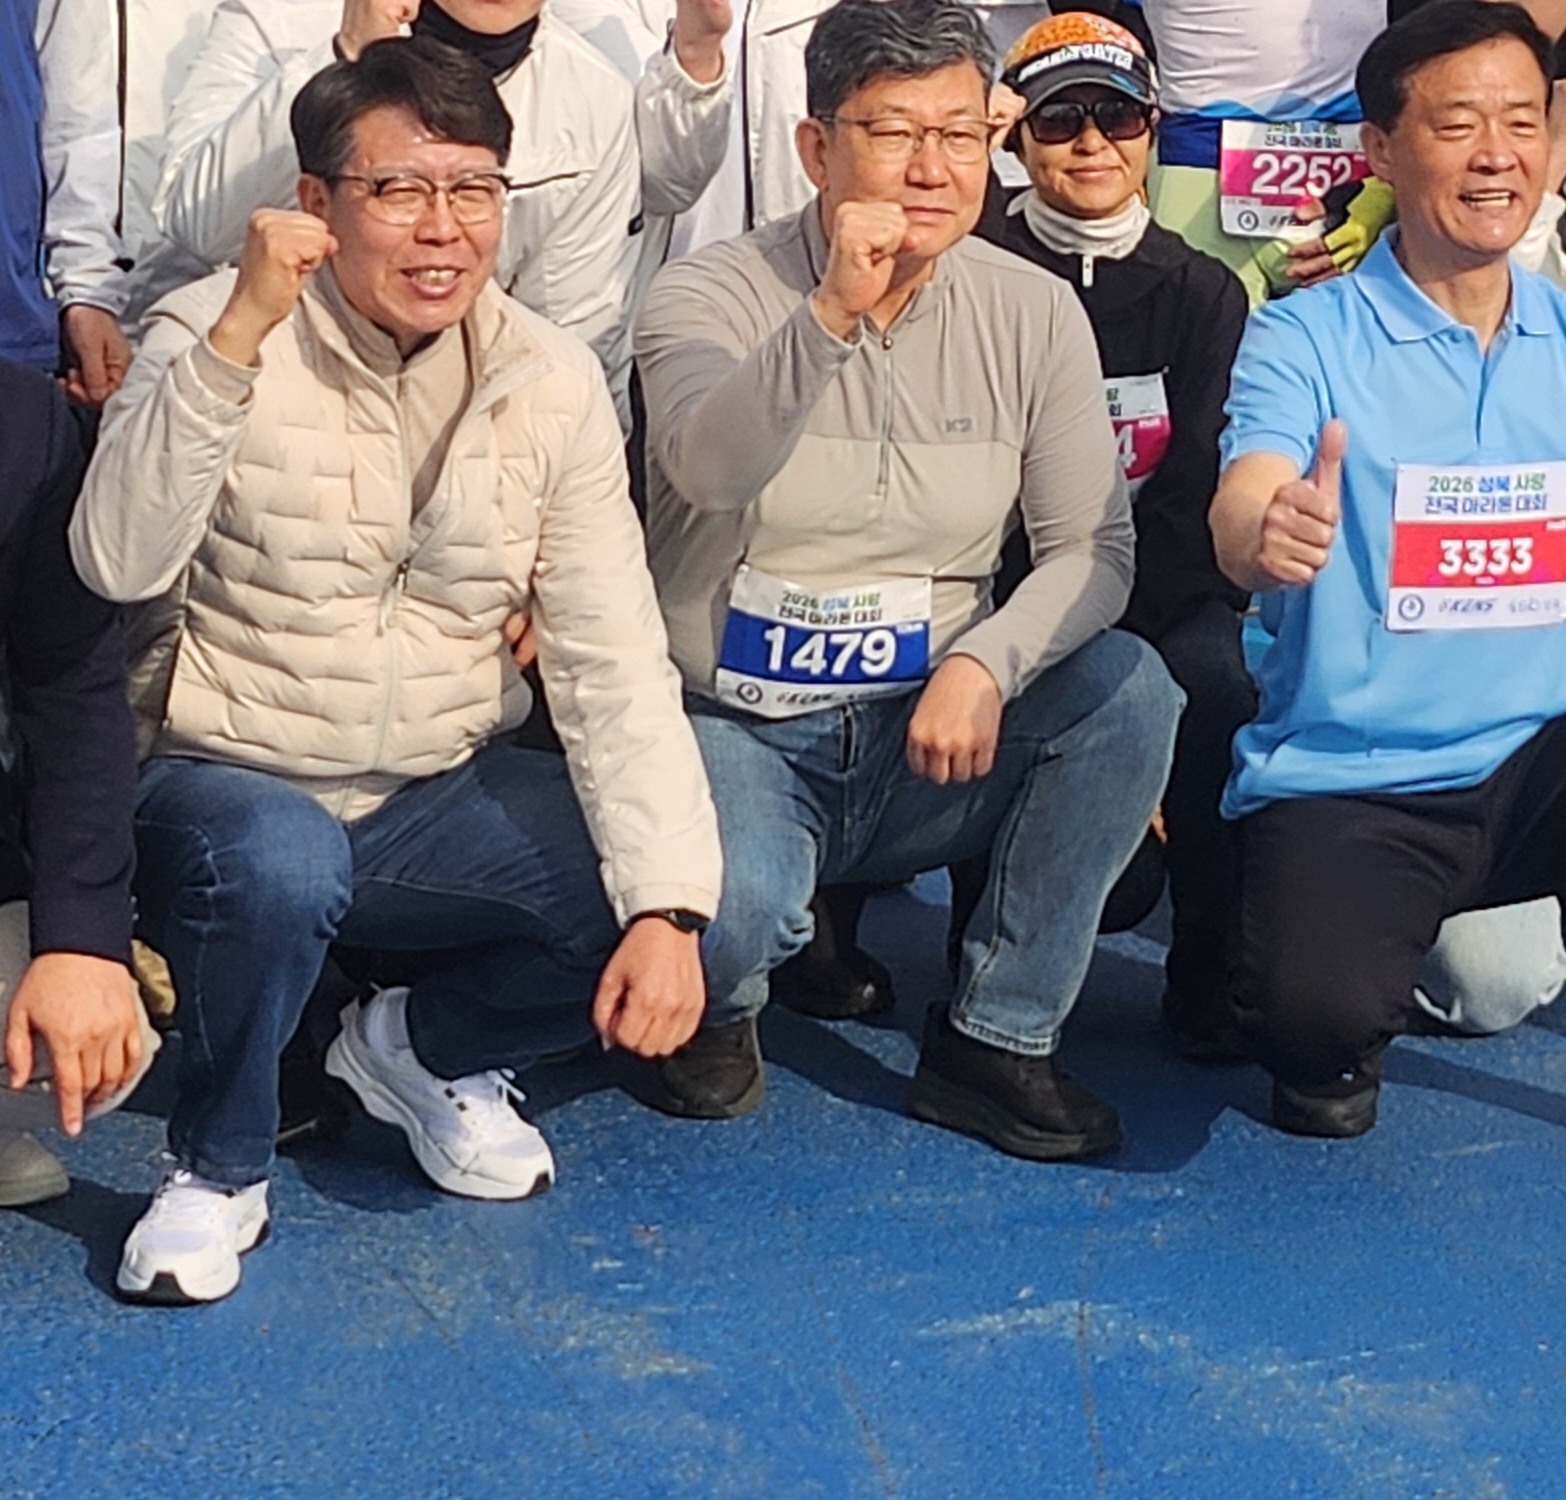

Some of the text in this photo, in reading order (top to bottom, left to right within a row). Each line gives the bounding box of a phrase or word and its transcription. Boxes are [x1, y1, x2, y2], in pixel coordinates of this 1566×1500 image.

[1428, 475, 1474, 493] 2026
[1438, 537, 1535, 576] 3333
[764, 625, 897, 677] 1479
